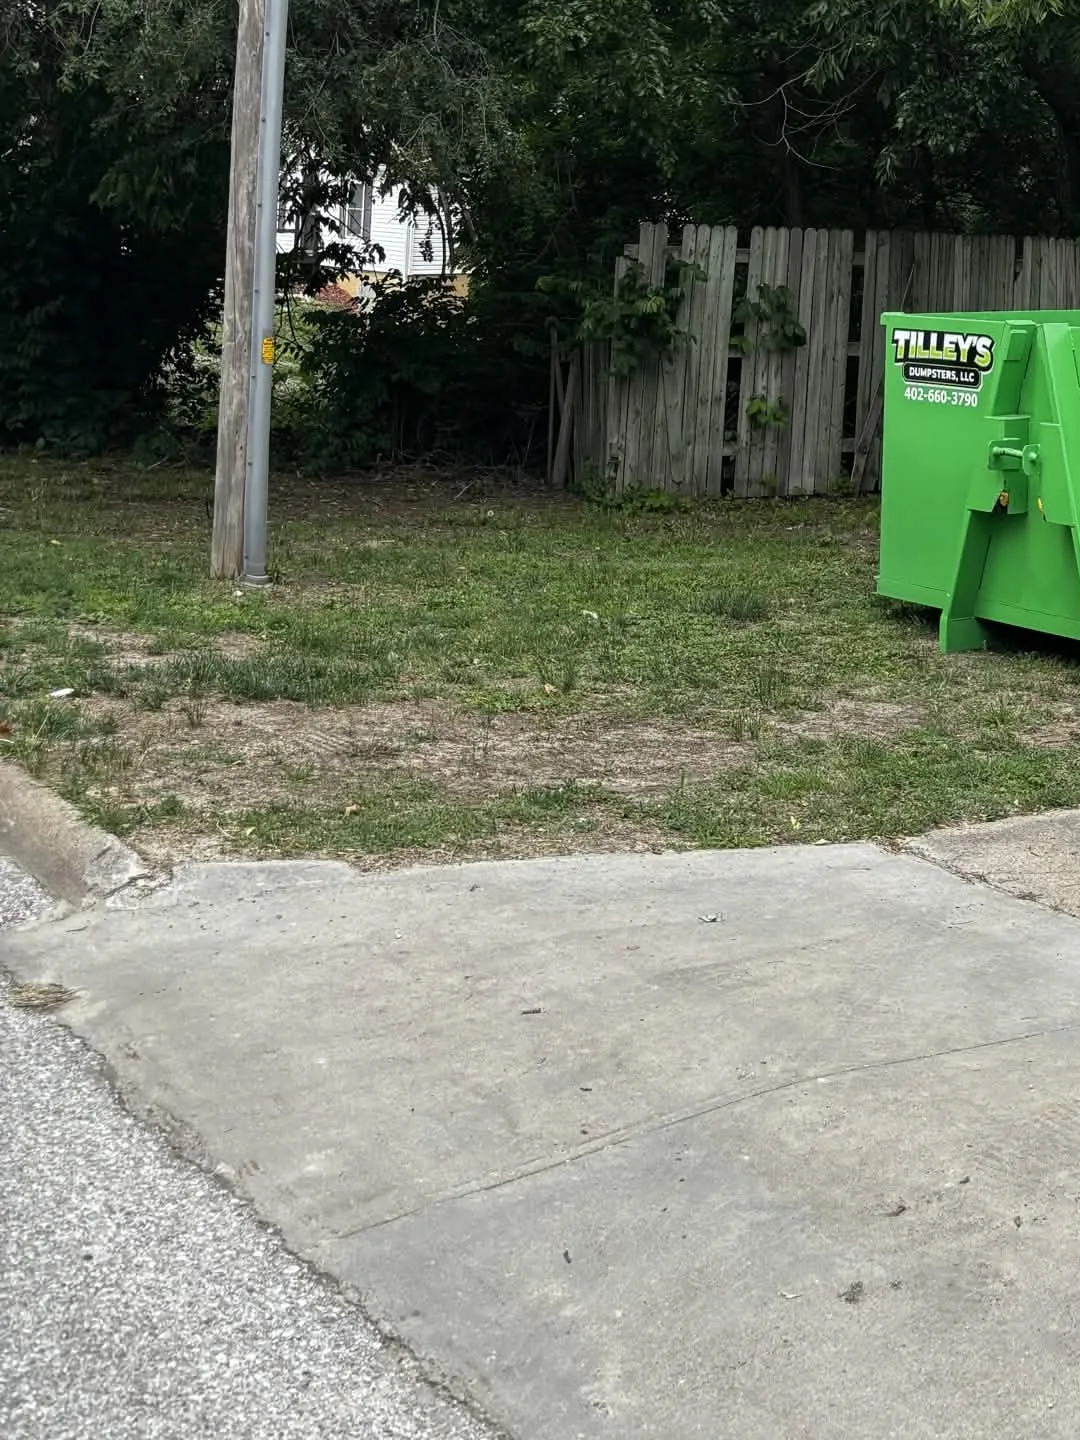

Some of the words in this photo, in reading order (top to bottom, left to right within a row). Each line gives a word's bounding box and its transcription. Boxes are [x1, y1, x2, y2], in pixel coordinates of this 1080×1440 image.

[893, 329, 992, 367] TILLEY'S
[909, 367, 958, 382] DUMPSTERS,
[960, 372, 975, 382] LLC
[904, 387, 978, 407] 402-660-3790
